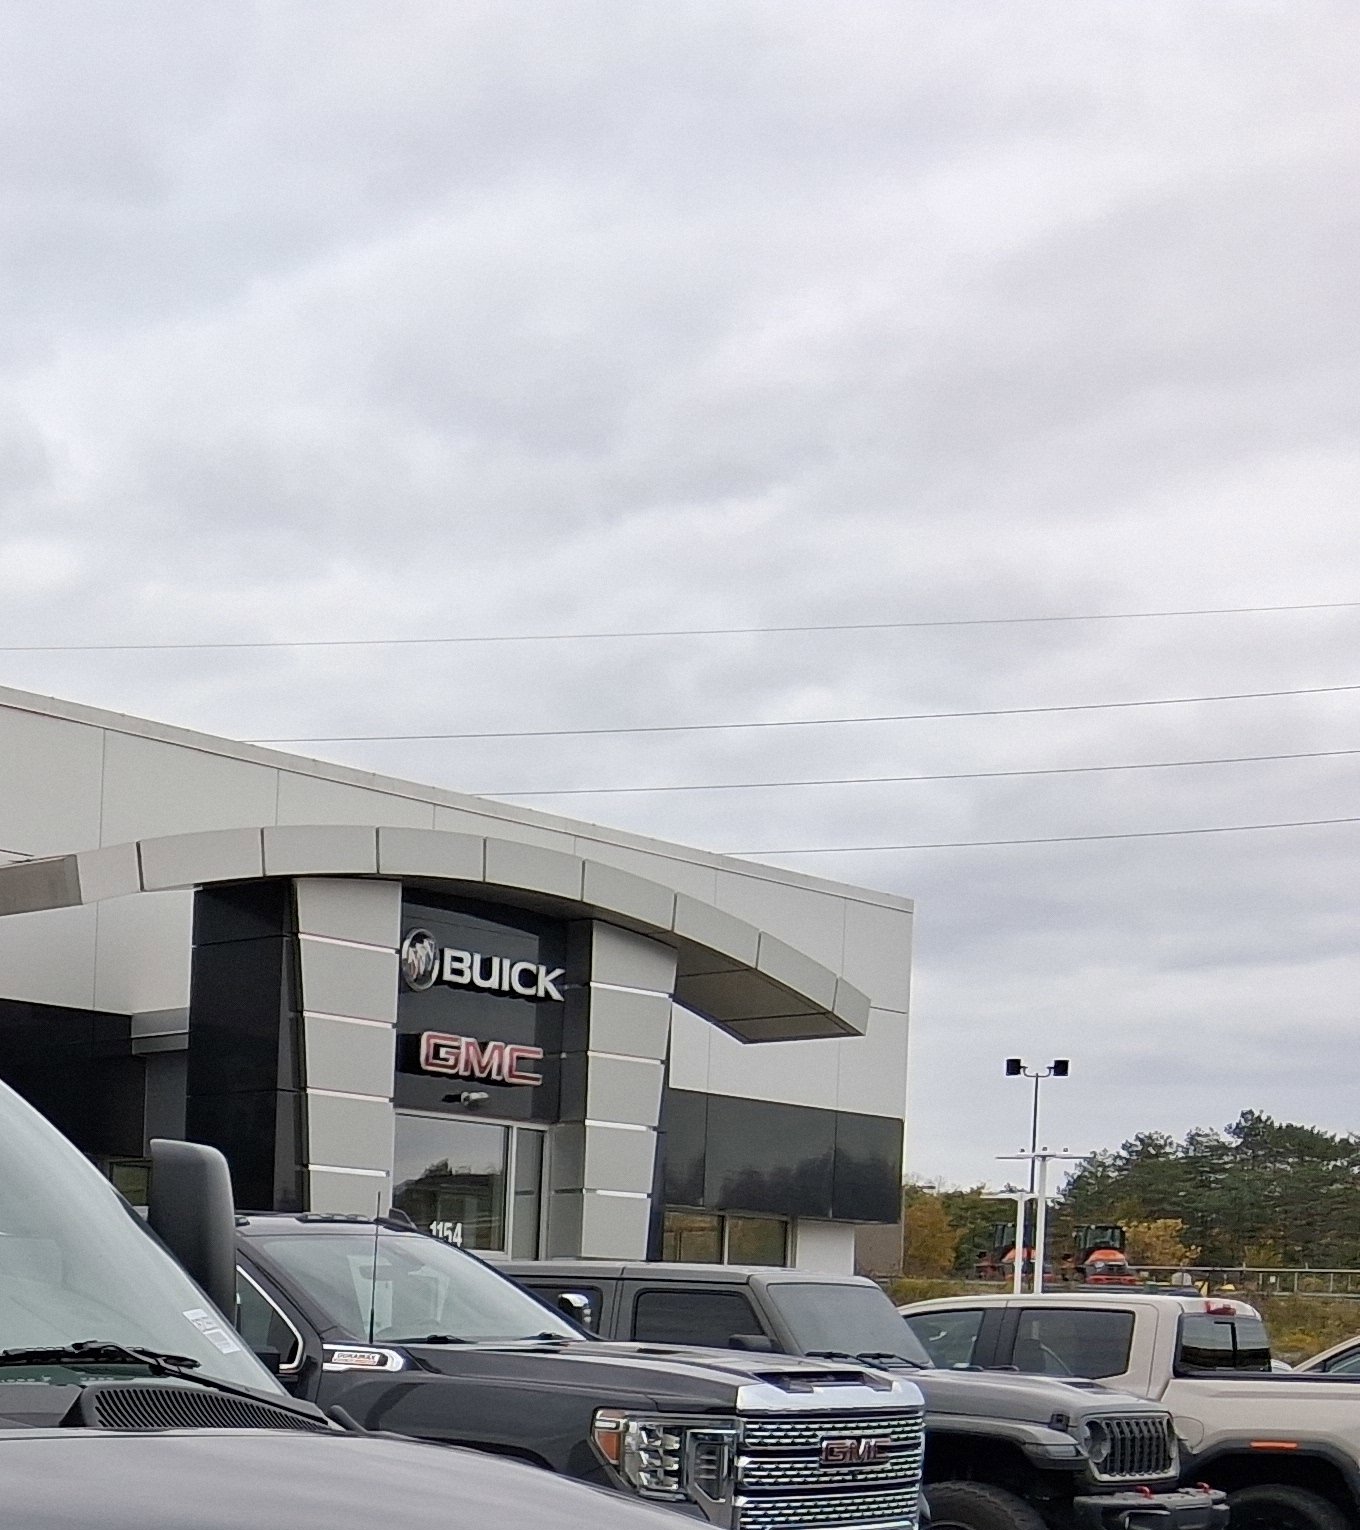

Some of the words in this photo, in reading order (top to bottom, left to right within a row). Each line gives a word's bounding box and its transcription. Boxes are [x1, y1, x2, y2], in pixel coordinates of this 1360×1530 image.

[442, 947, 566, 1002] BUICK
[419, 1030, 544, 1086] GMC
[429, 1220, 463, 1248] 1154
[821, 1437, 891, 1465] GMC
